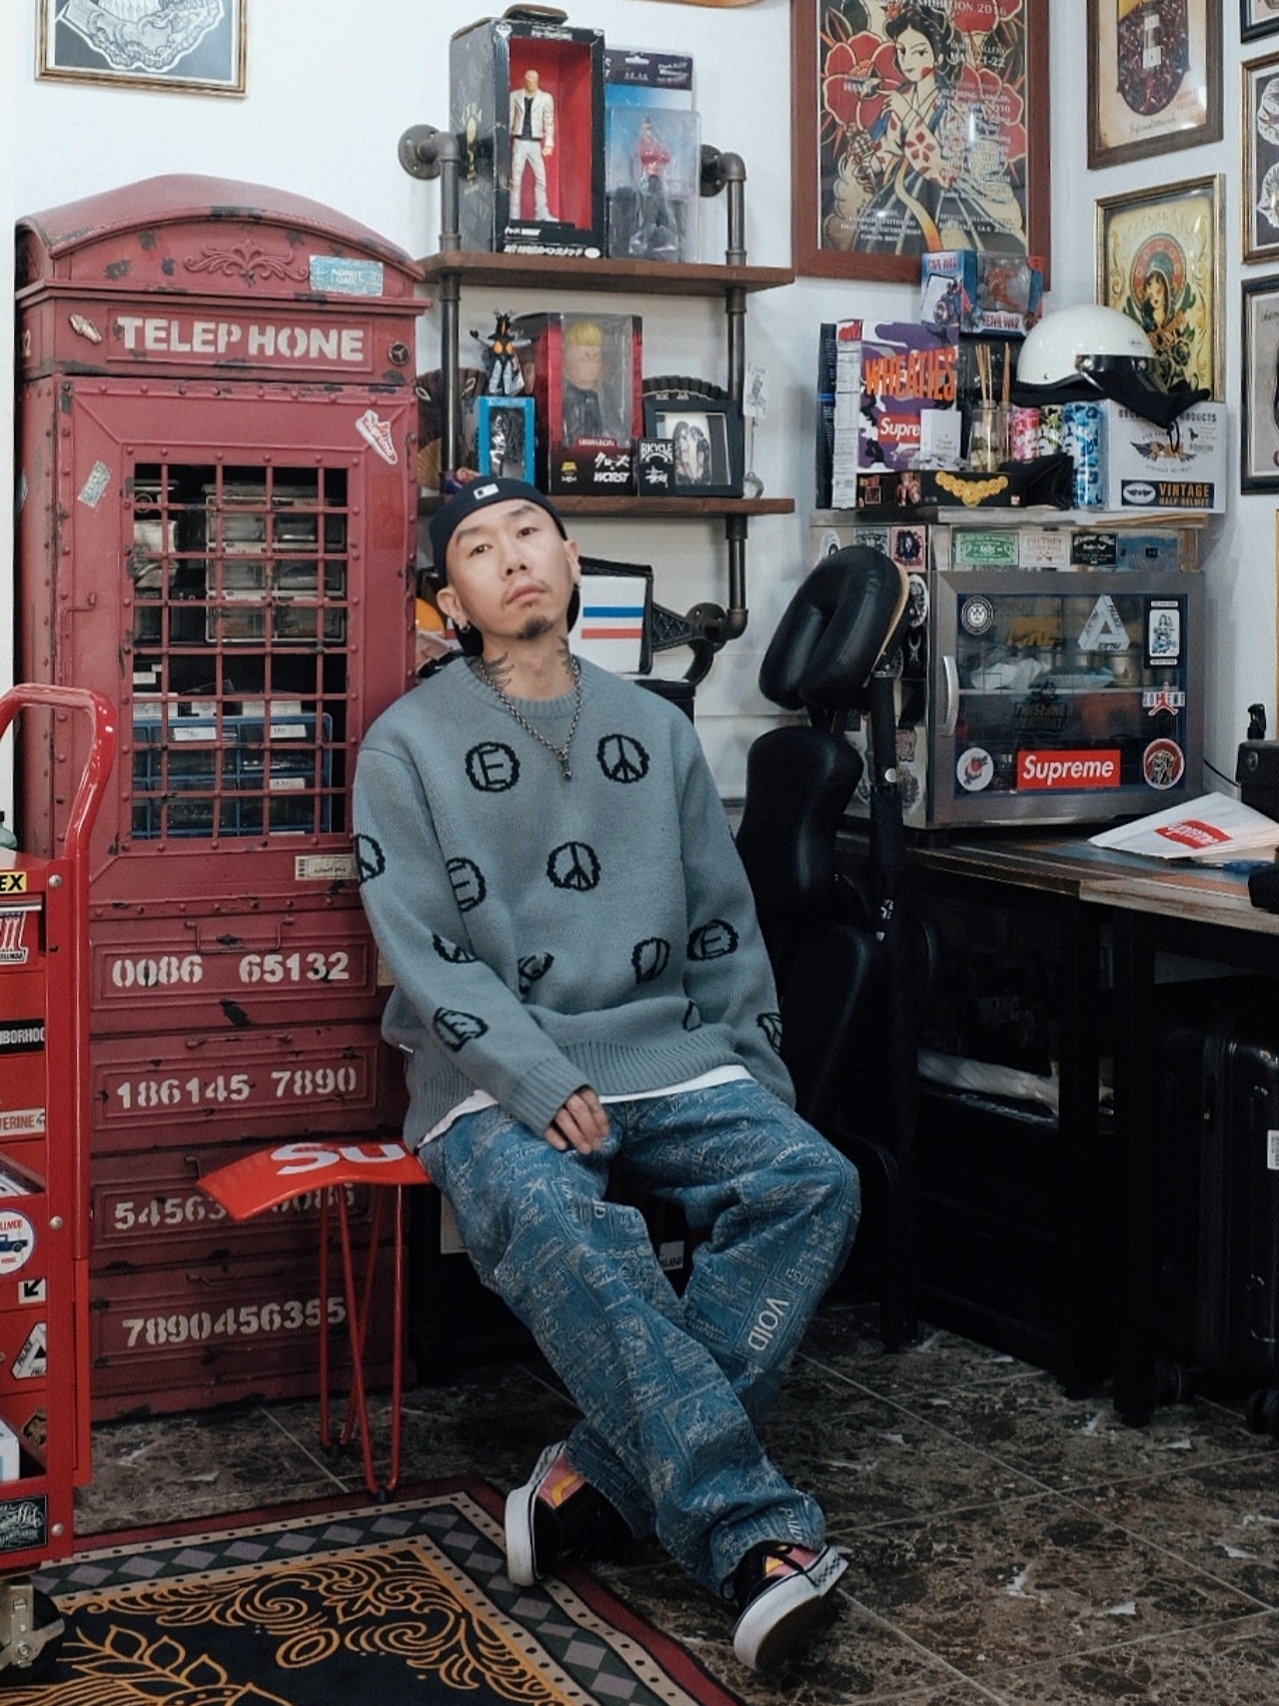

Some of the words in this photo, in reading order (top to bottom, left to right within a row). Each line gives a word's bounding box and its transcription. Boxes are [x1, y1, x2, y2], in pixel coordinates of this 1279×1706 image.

[116, 315, 364, 363] TELEPHONE
[865, 348, 957, 400] WHEATIES
[880, 416, 920, 442] Supre
[640, 442, 673, 454] BICYCLE
[593, 472, 631, 483] WORST
[1159, 483, 1211, 498] VINTAGE
[1023, 754, 1114, 785] Supreme
[112, 956, 202, 988] 0086
[239, 952, 349, 983] 65132
[117, 1074, 250, 1109] 186145
[271, 1067, 357, 1097] 7890
[0, 1114, 34, 1130] ERINE
[122, 1297, 347, 1347] 7890456355
[747, 1297, 790, 1351] VOID
